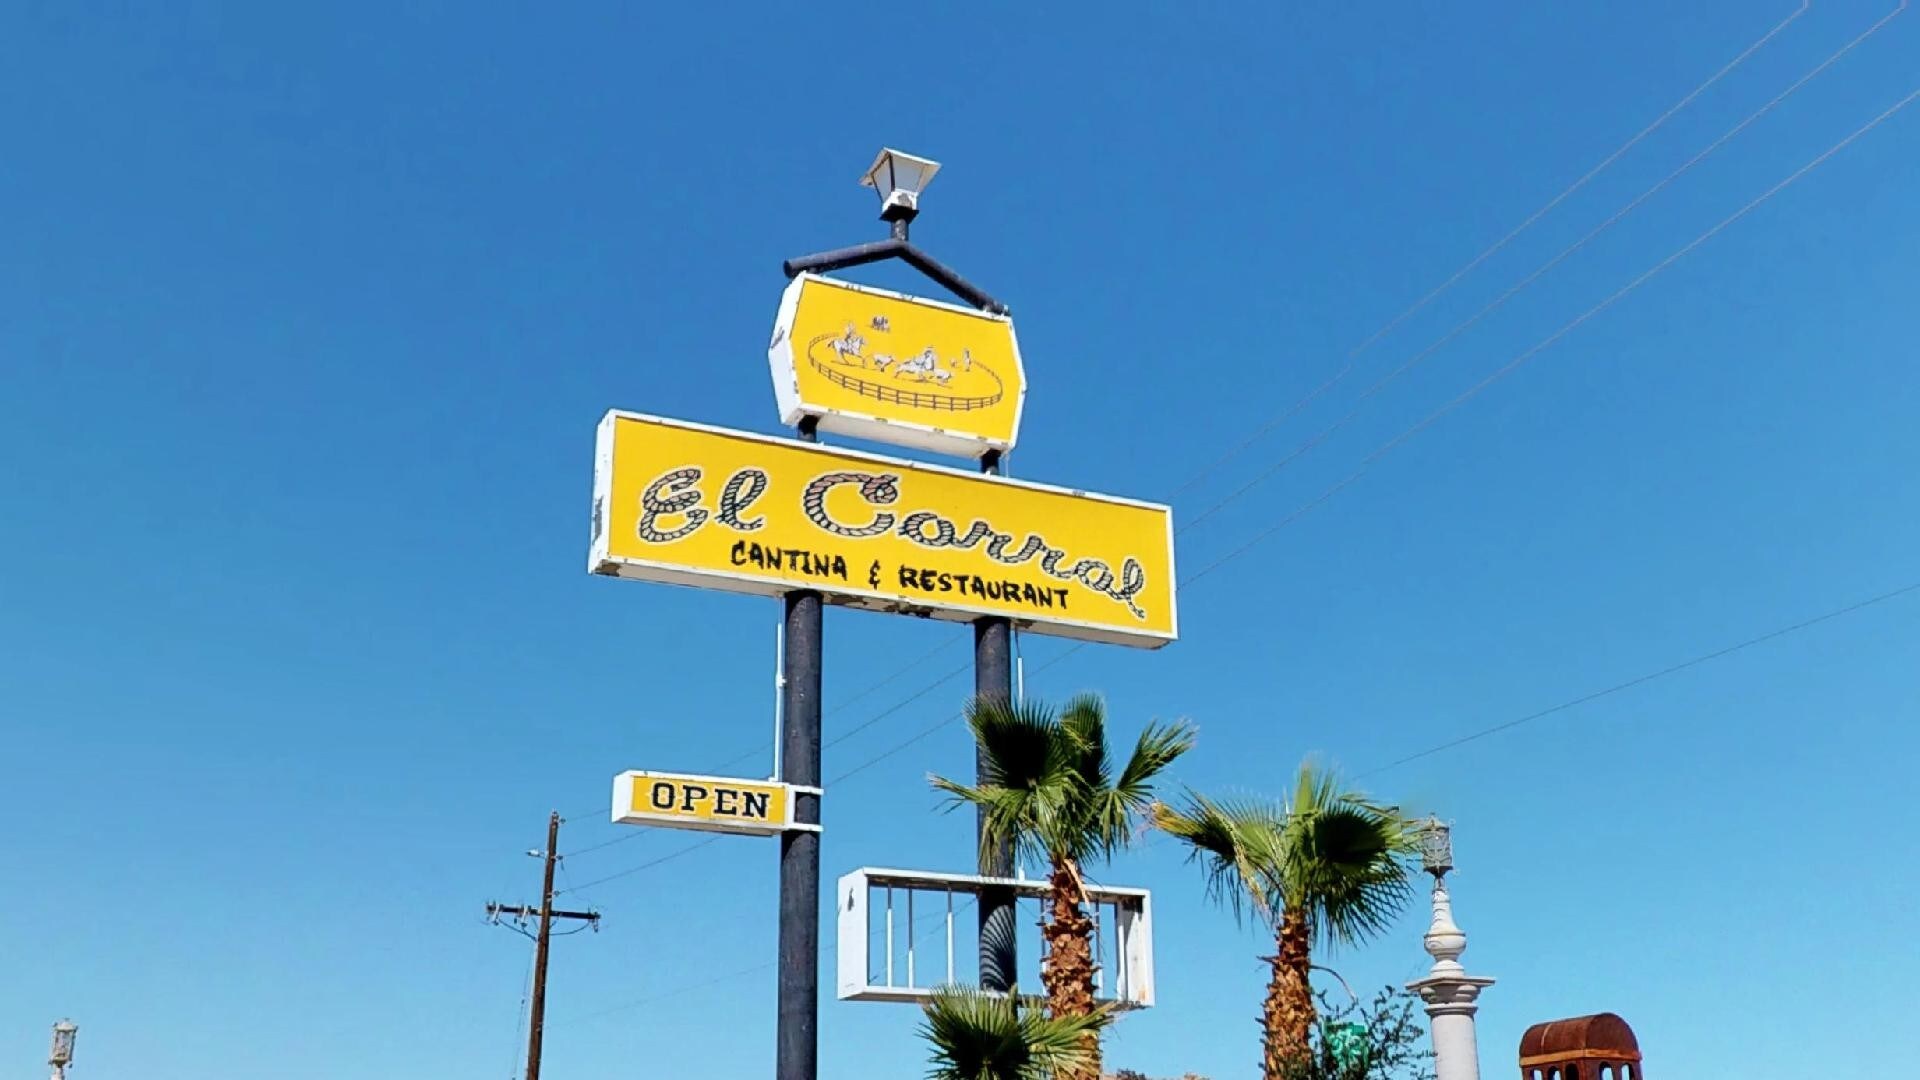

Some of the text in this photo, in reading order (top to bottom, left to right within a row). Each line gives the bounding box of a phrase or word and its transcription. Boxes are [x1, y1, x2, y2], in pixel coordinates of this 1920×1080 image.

[638, 467, 1146, 619] El Corral
[730, 539, 1069, 609] CANTINA & RESTAURANT
[651, 782, 770, 818] OPEN
